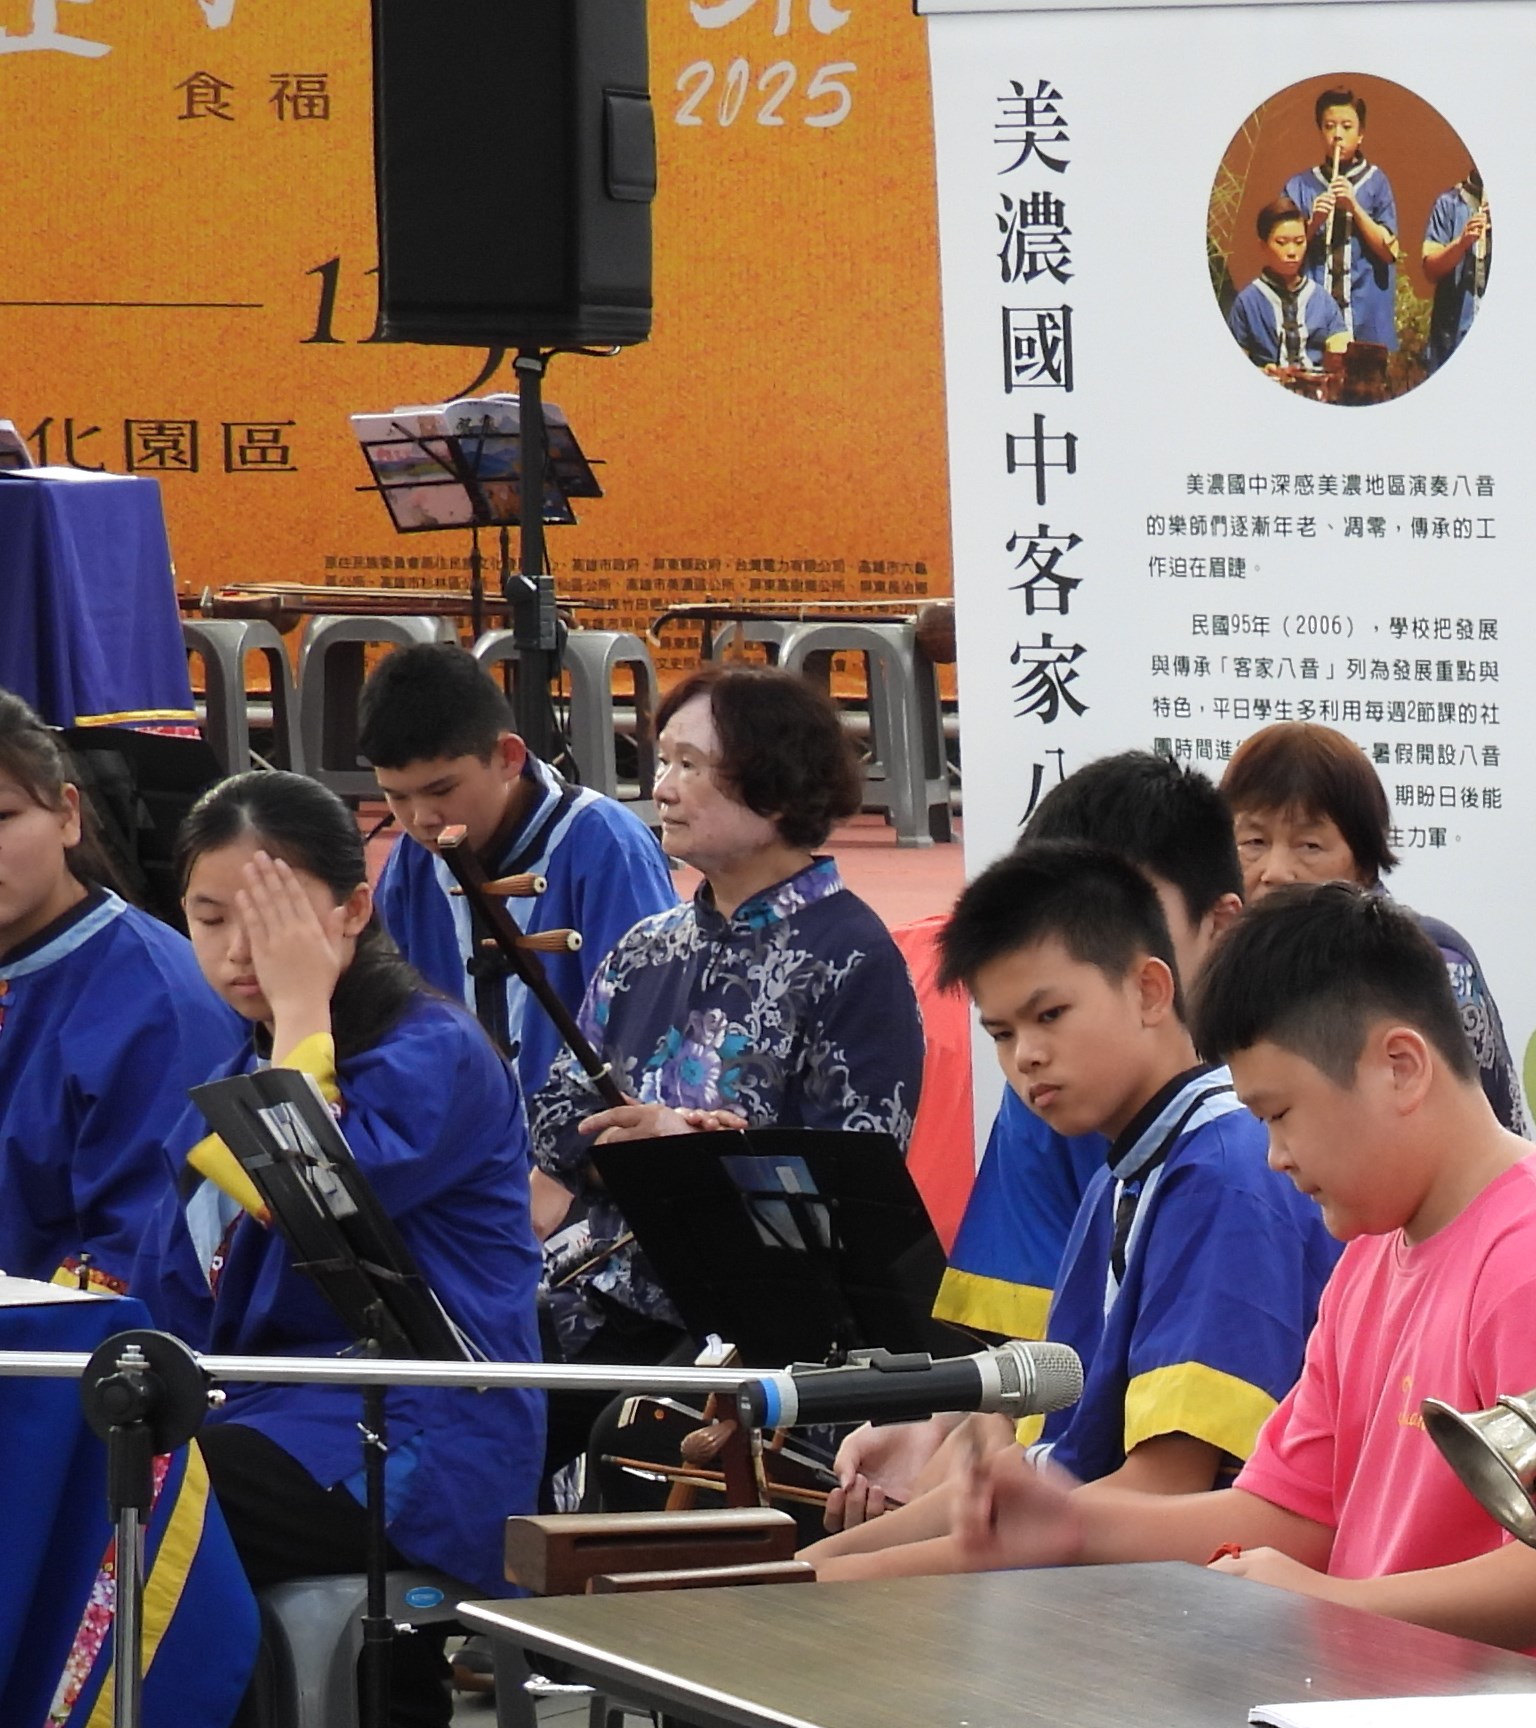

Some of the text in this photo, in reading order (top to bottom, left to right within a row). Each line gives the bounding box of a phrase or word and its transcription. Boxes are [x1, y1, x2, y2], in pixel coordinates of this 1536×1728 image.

[174, 71, 330, 121] 食福
[676, 58, 858, 128] 2025
[27, 417, 299, 473] 化園區
[1186, 473, 1496, 498] 美濃國中深感美濃地區演奏八音
[1148, 555, 1261, 580] 作迫在眉睫。
